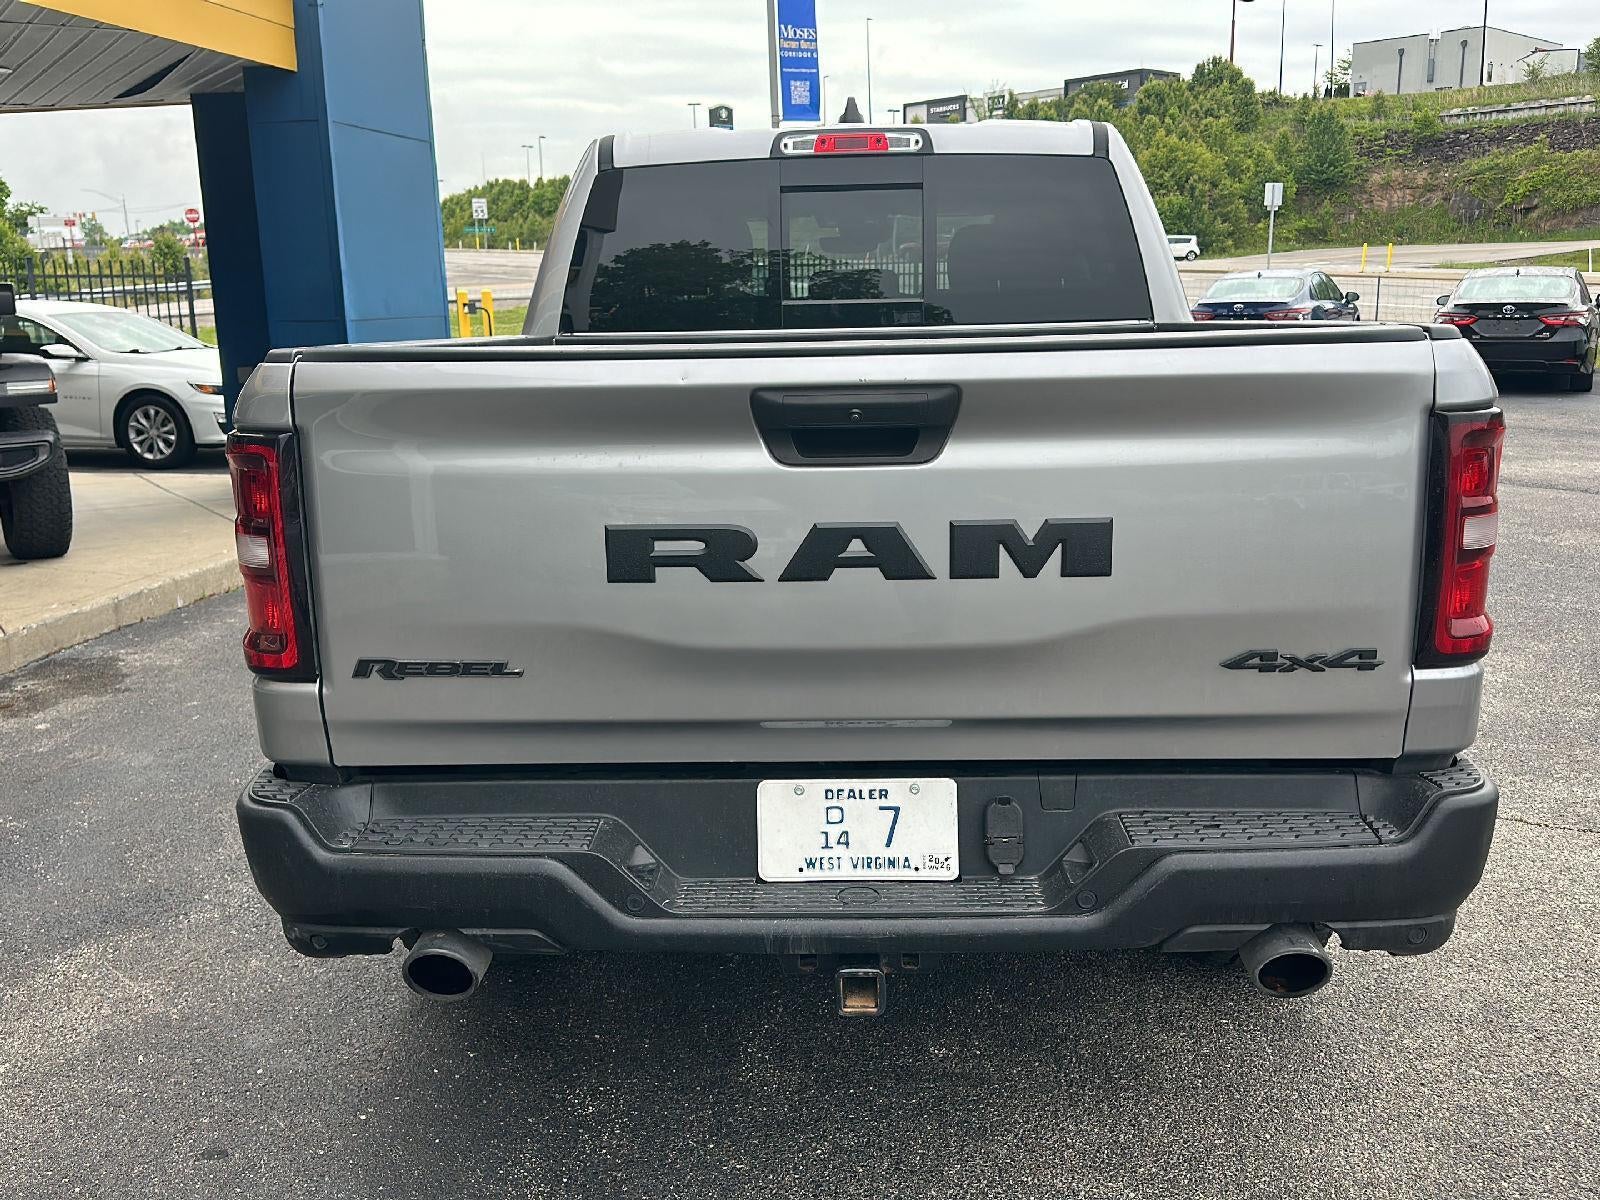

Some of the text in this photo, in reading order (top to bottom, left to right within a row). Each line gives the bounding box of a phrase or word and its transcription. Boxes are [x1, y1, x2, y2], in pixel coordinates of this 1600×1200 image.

[780, 24, 816, 39] MOSES
[930, 103, 960, 114] STARBUCKS
[605, 517, 1113, 582] RAM
[352, 657, 525, 681] REBEL
[824, 788, 889, 800] DEALER
[825, 805, 844, 824] D
[878, 805, 901, 848] 7
[820, 831, 850, 850] 14
[804, 856, 842, 870] WEST
[849, 855, 912, 870] VIRGINIA
